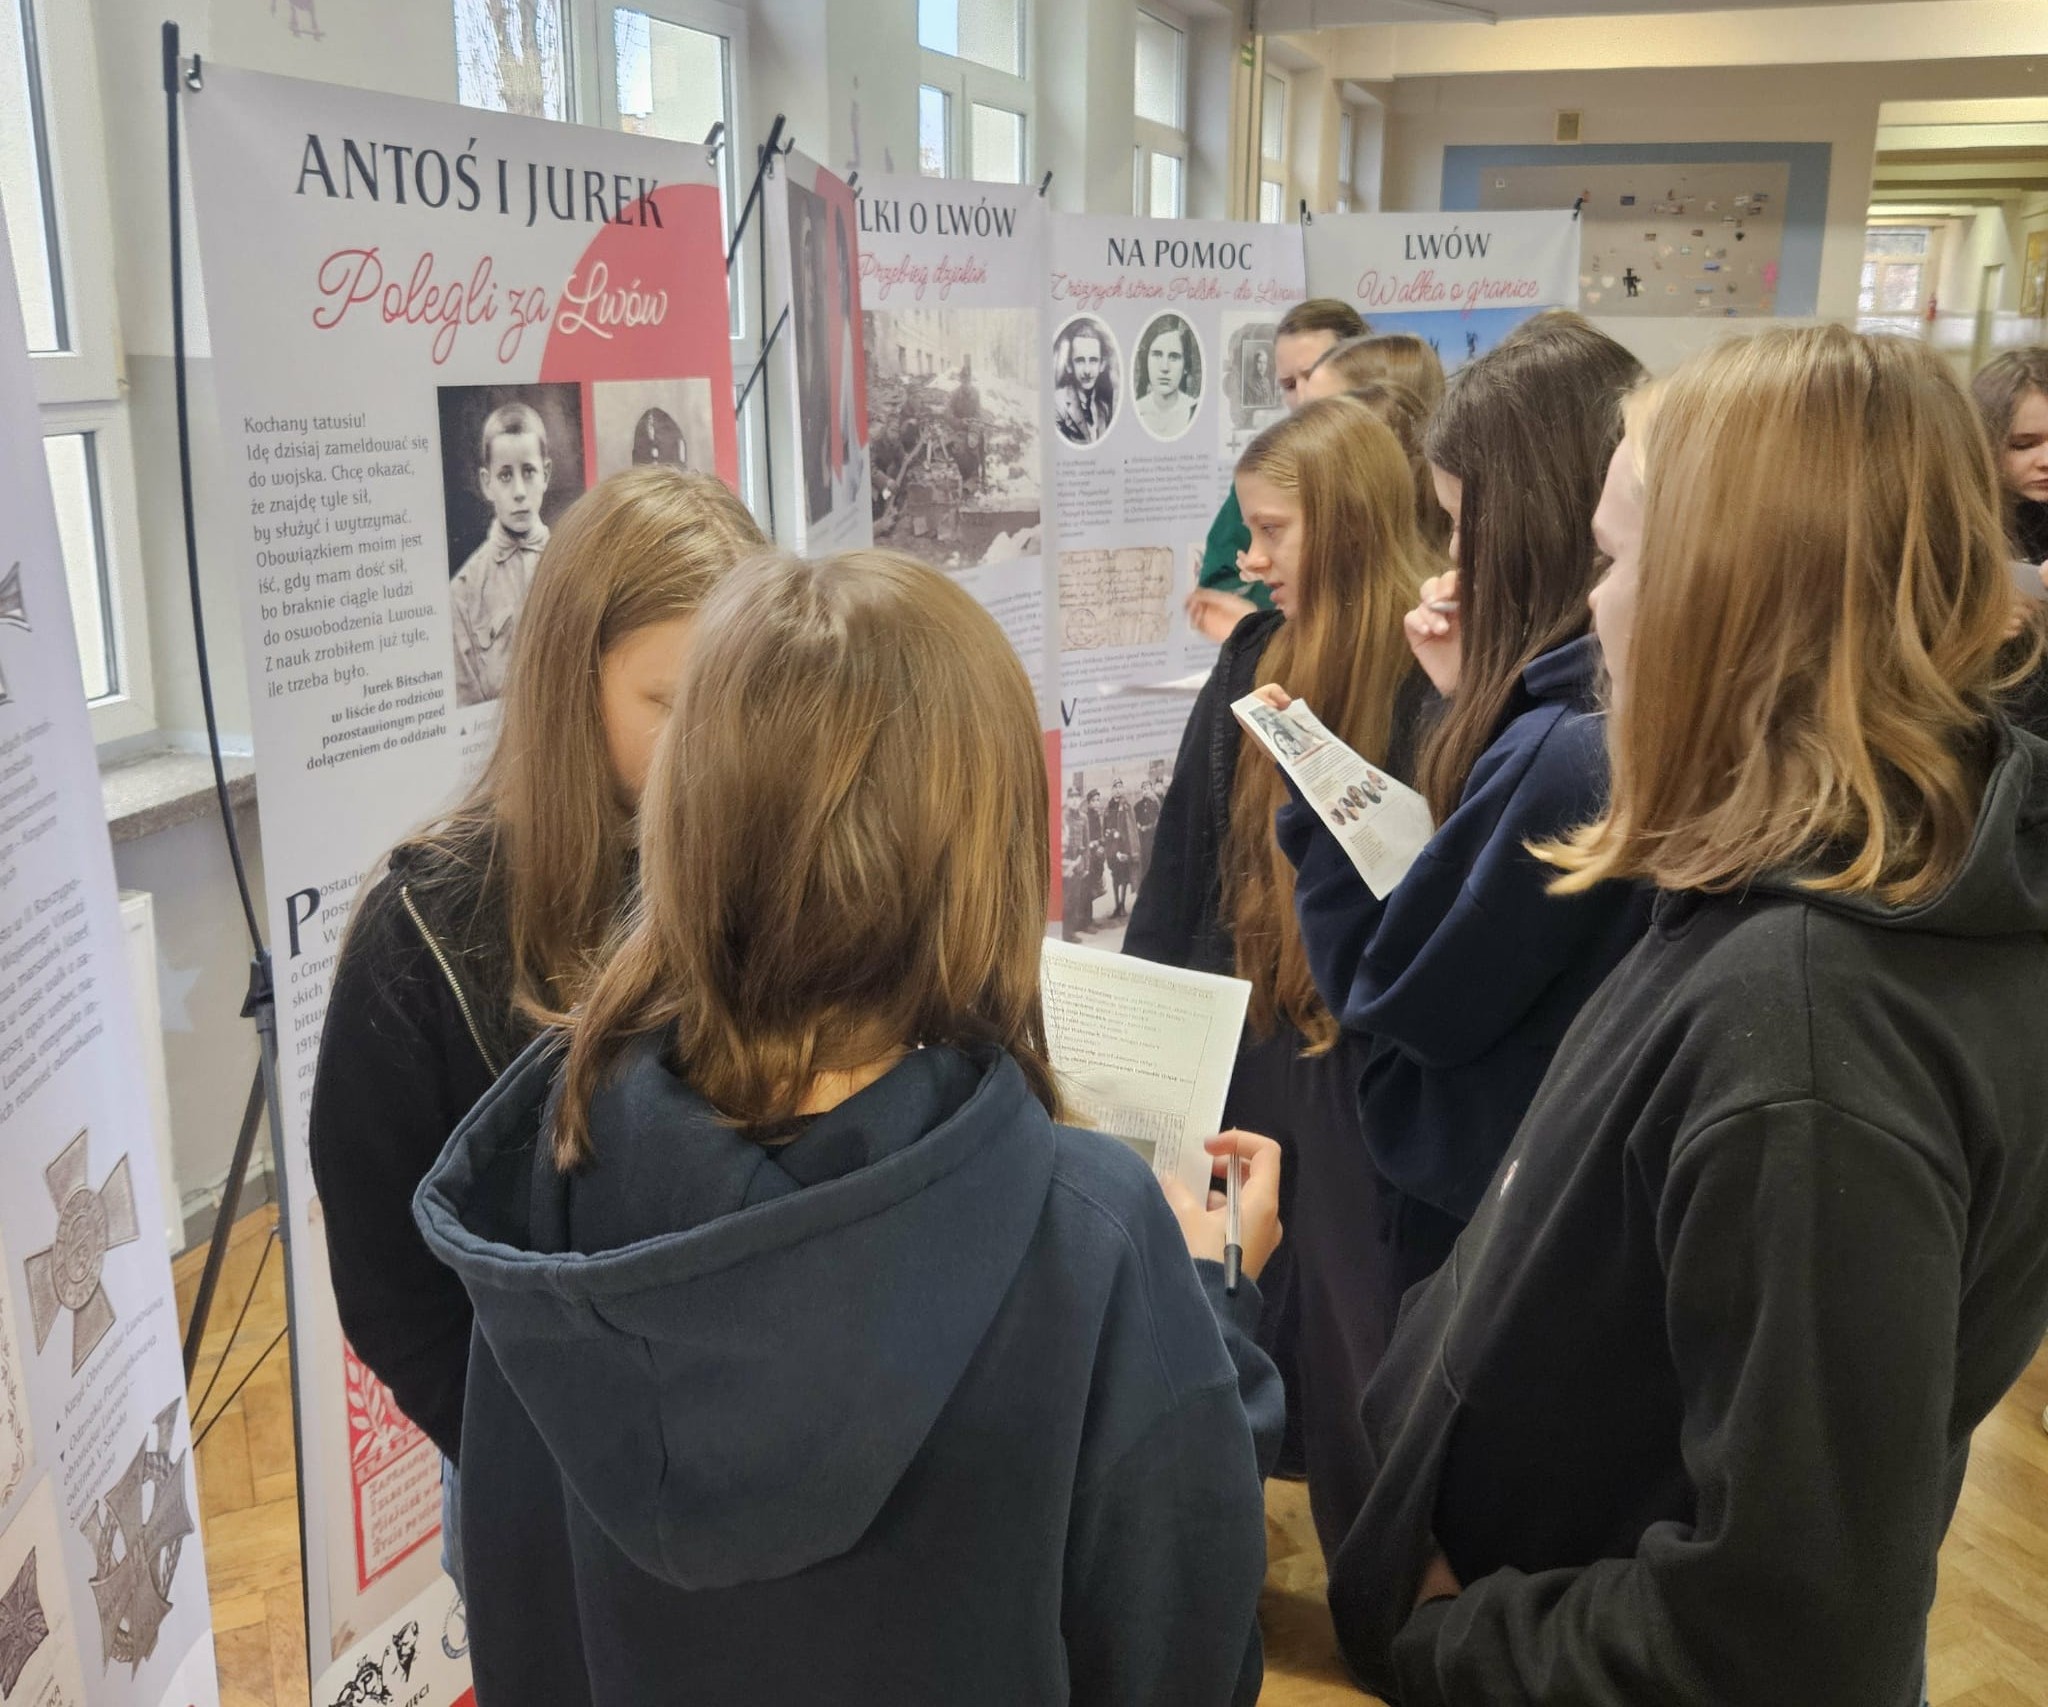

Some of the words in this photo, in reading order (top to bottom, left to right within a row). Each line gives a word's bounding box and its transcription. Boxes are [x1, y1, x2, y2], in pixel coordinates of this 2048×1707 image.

[296, 133, 482, 212] ANTOŚ
[498, 158, 511, 214] I
[526, 162, 665, 229] JUREK
[860, 199, 900, 233] LKI
[910, 202, 927, 235] O
[936, 196, 1017, 238] LWÓW
[1107, 238, 1146, 267] NA
[1154, 239, 1253, 271] POMOC
[1405, 225, 1492, 260] LWÓW
[313, 247, 498, 365] Polegli
[498, 285, 552, 364] za
[556, 261, 669, 339] Lwów
[1357, 269, 1446, 307] Walka
[1450, 283, 1464, 299] o
[1460, 277, 1541, 320] granice
[244, 414, 308, 435] Kochany
[313, 412, 366, 431] tatusiu!
[247, 444, 270, 464] Idę
[274, 441, 320, 460] dzisiaj
[324, 436, 408, 456] zameldować
[412, 435, 429, 453] się
[249, 471, 266, 488] do
[272, 466, 327, 487] wojska.
[331, 465, 363, 483] Chcę
[251, 498, 265, 515] że
[270, 493, 317, 514] znajdę
[321, 490, 348, 511] tyle
[352, 488, 372, 505] sił,
[253, 525, 271, 545] by
[276, 518, 321, 540] służyć
[256, 543, 353, 567] Obowiązkiem
[358, 537, 396, 555] moim
[400, 534, 423, 552] jest
[258, 573, 281, 595] iść,
[284, 573, 310, 594] gdy
[316, 569, 351, 586] mam
[356, 562, 386, 579] dość
[261, 604, 277, 620] bo
[282, 594, 336, 616] braknie
[339, 586, 379, 609] ciągle
[383, 582, 415, 599] ludzi
[263, 630, 280, 646] do
[284, 609, 384, 643] oswobodzenia
[265, 656, 273, 673] Z
[276, 647, 311, 669] nauk
[314, 638, 374, 662] zrobiłem
[379, 632, 398, 653] już
[268, 681, 283, 698] ile
[287, 672, 329, 693] trzeba
[362, 677, 394, 698] Jurek
[396, 669, 443, 689] Bitschan
[331, 711, 343, 724] w
[345, 701, 377, 722] liście
[378, 696, 393, 712] do
[395, 686, 444, 709] rodziców
[322, 713, 416, 748] pozostawionym
[417, 705, 446, 725] przed
[306, 740, 381, 771] dołączeniem
[383, 733, 398, 749] do
[400, 722, 447, 746] oddziału
[321, 900, 352, 924] post
[291, 972, 298, 984] o
[292, 982, 323, 1008] skich
